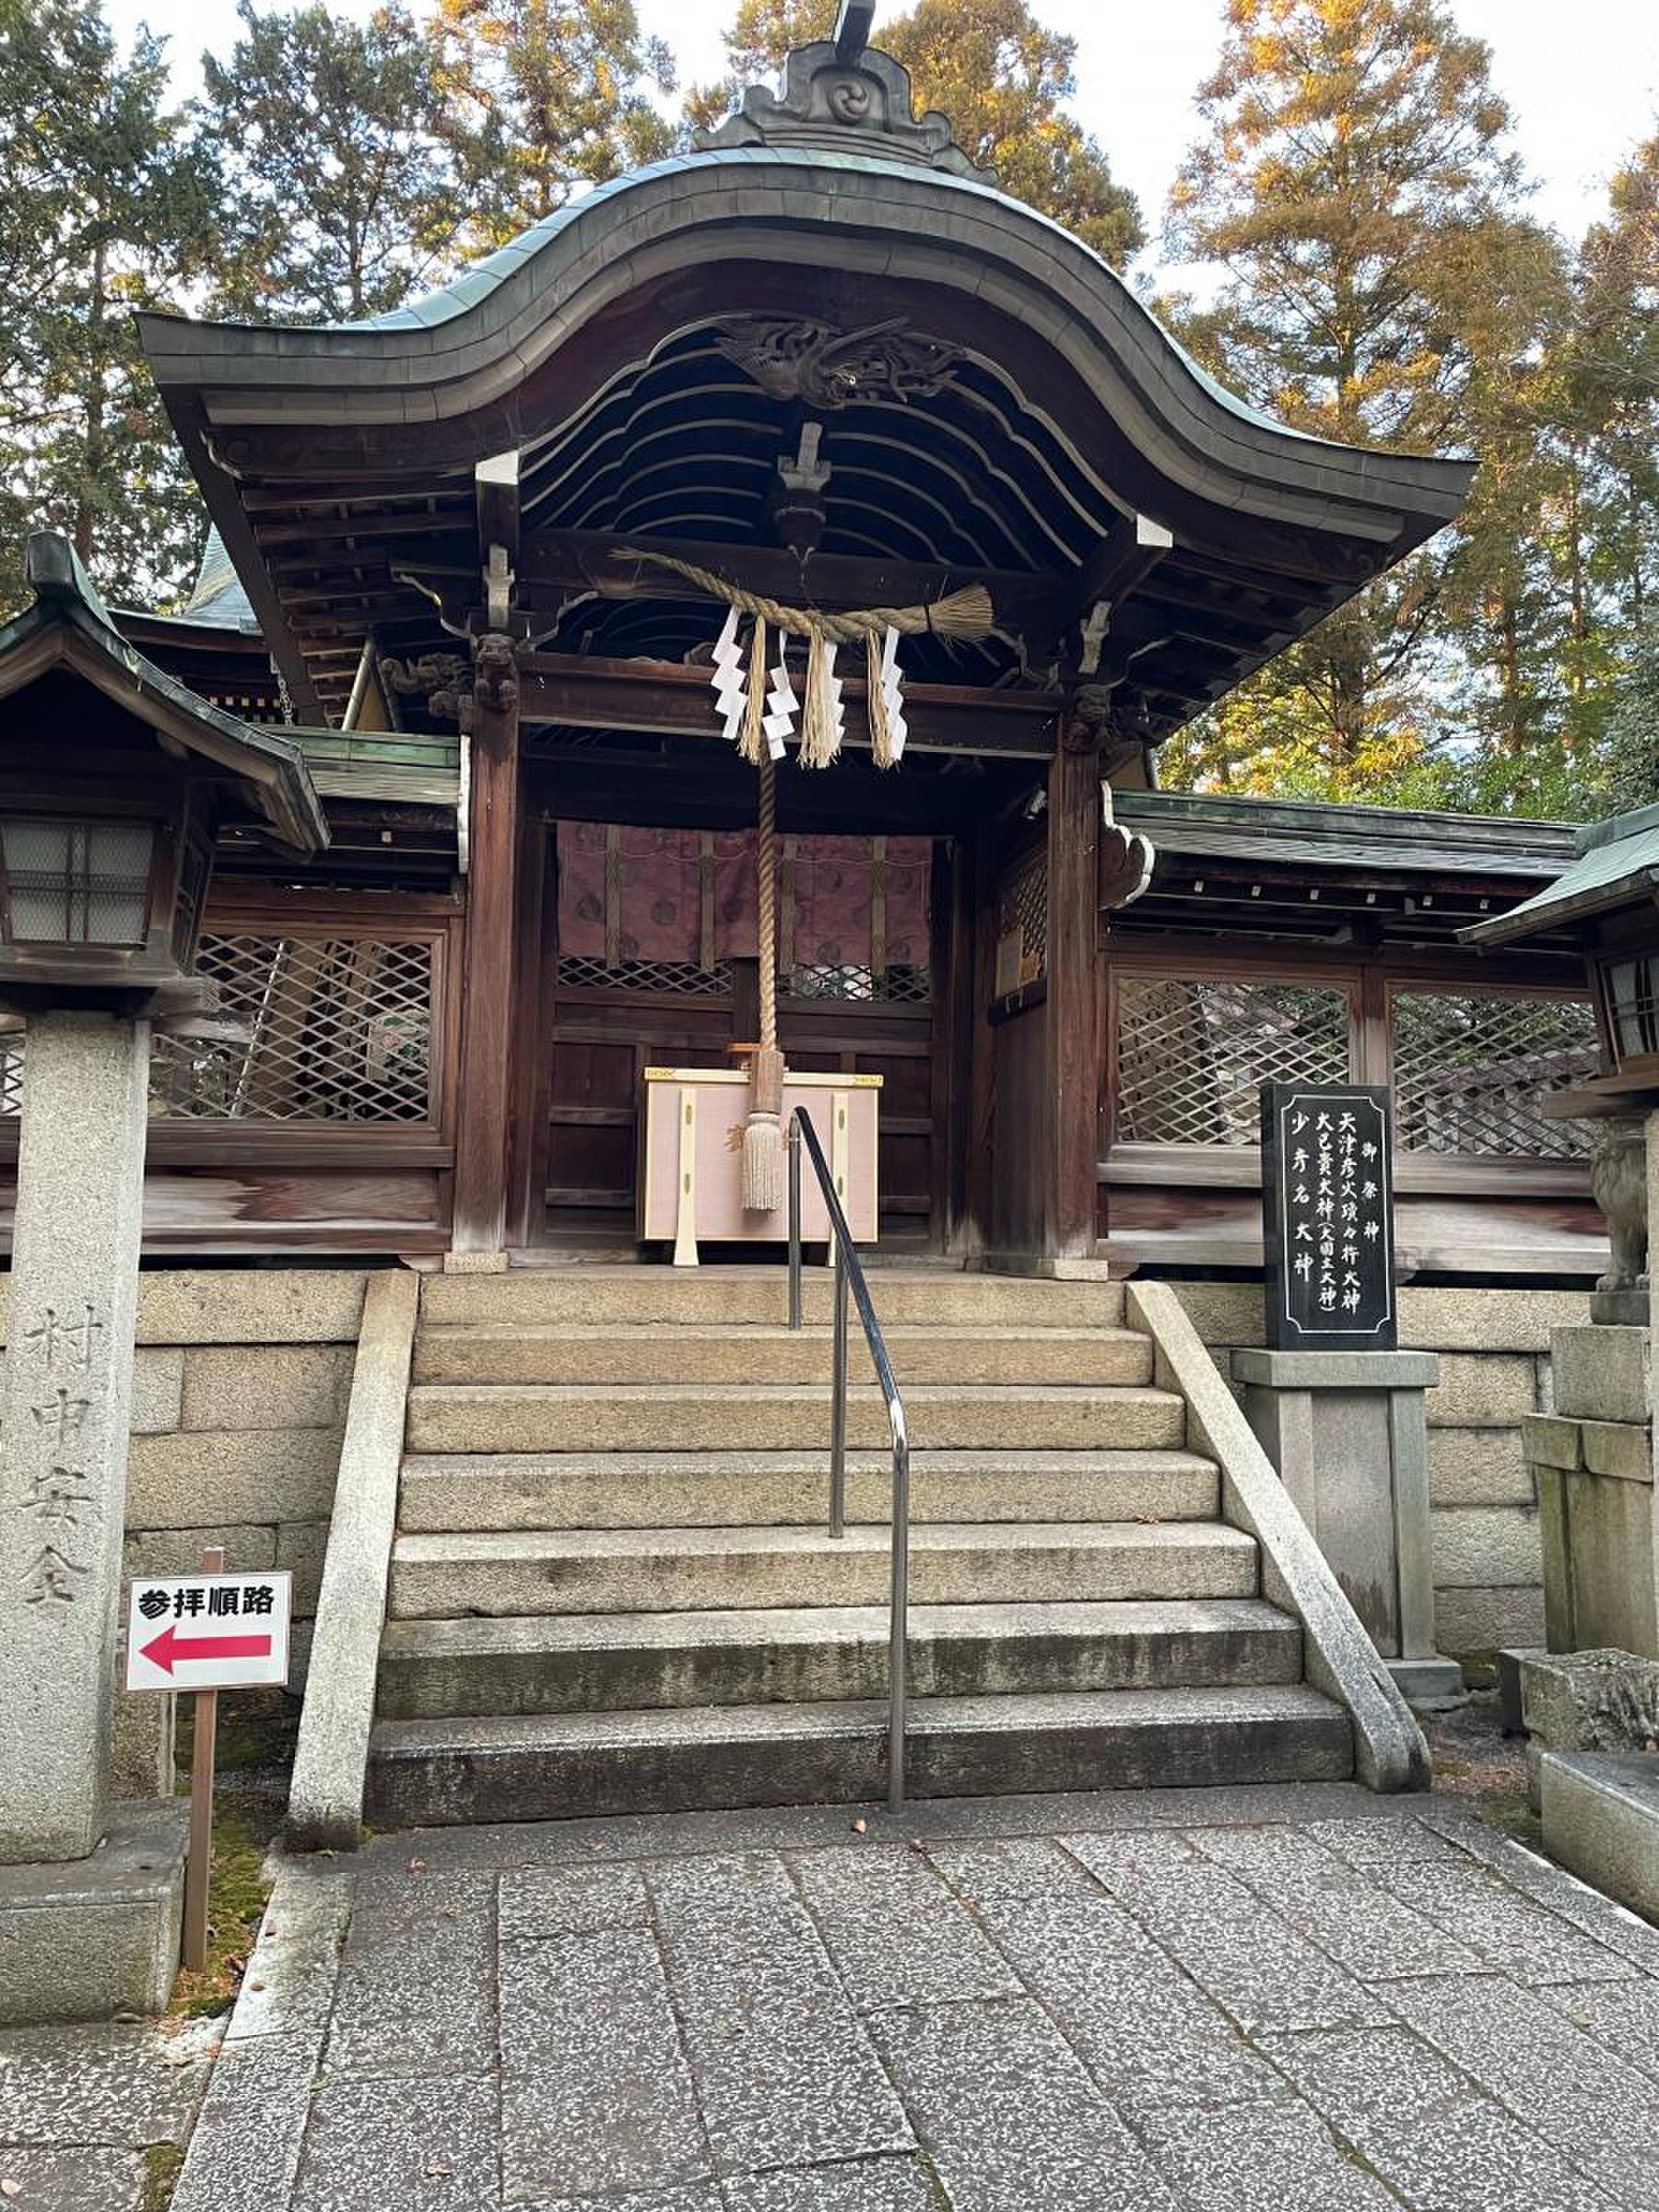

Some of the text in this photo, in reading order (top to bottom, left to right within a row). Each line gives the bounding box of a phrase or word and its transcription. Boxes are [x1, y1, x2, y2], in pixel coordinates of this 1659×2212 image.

[1361, 1142, 1380, 1242] 御祭神
[139, 1585, 275, 1619] 参拝順路
